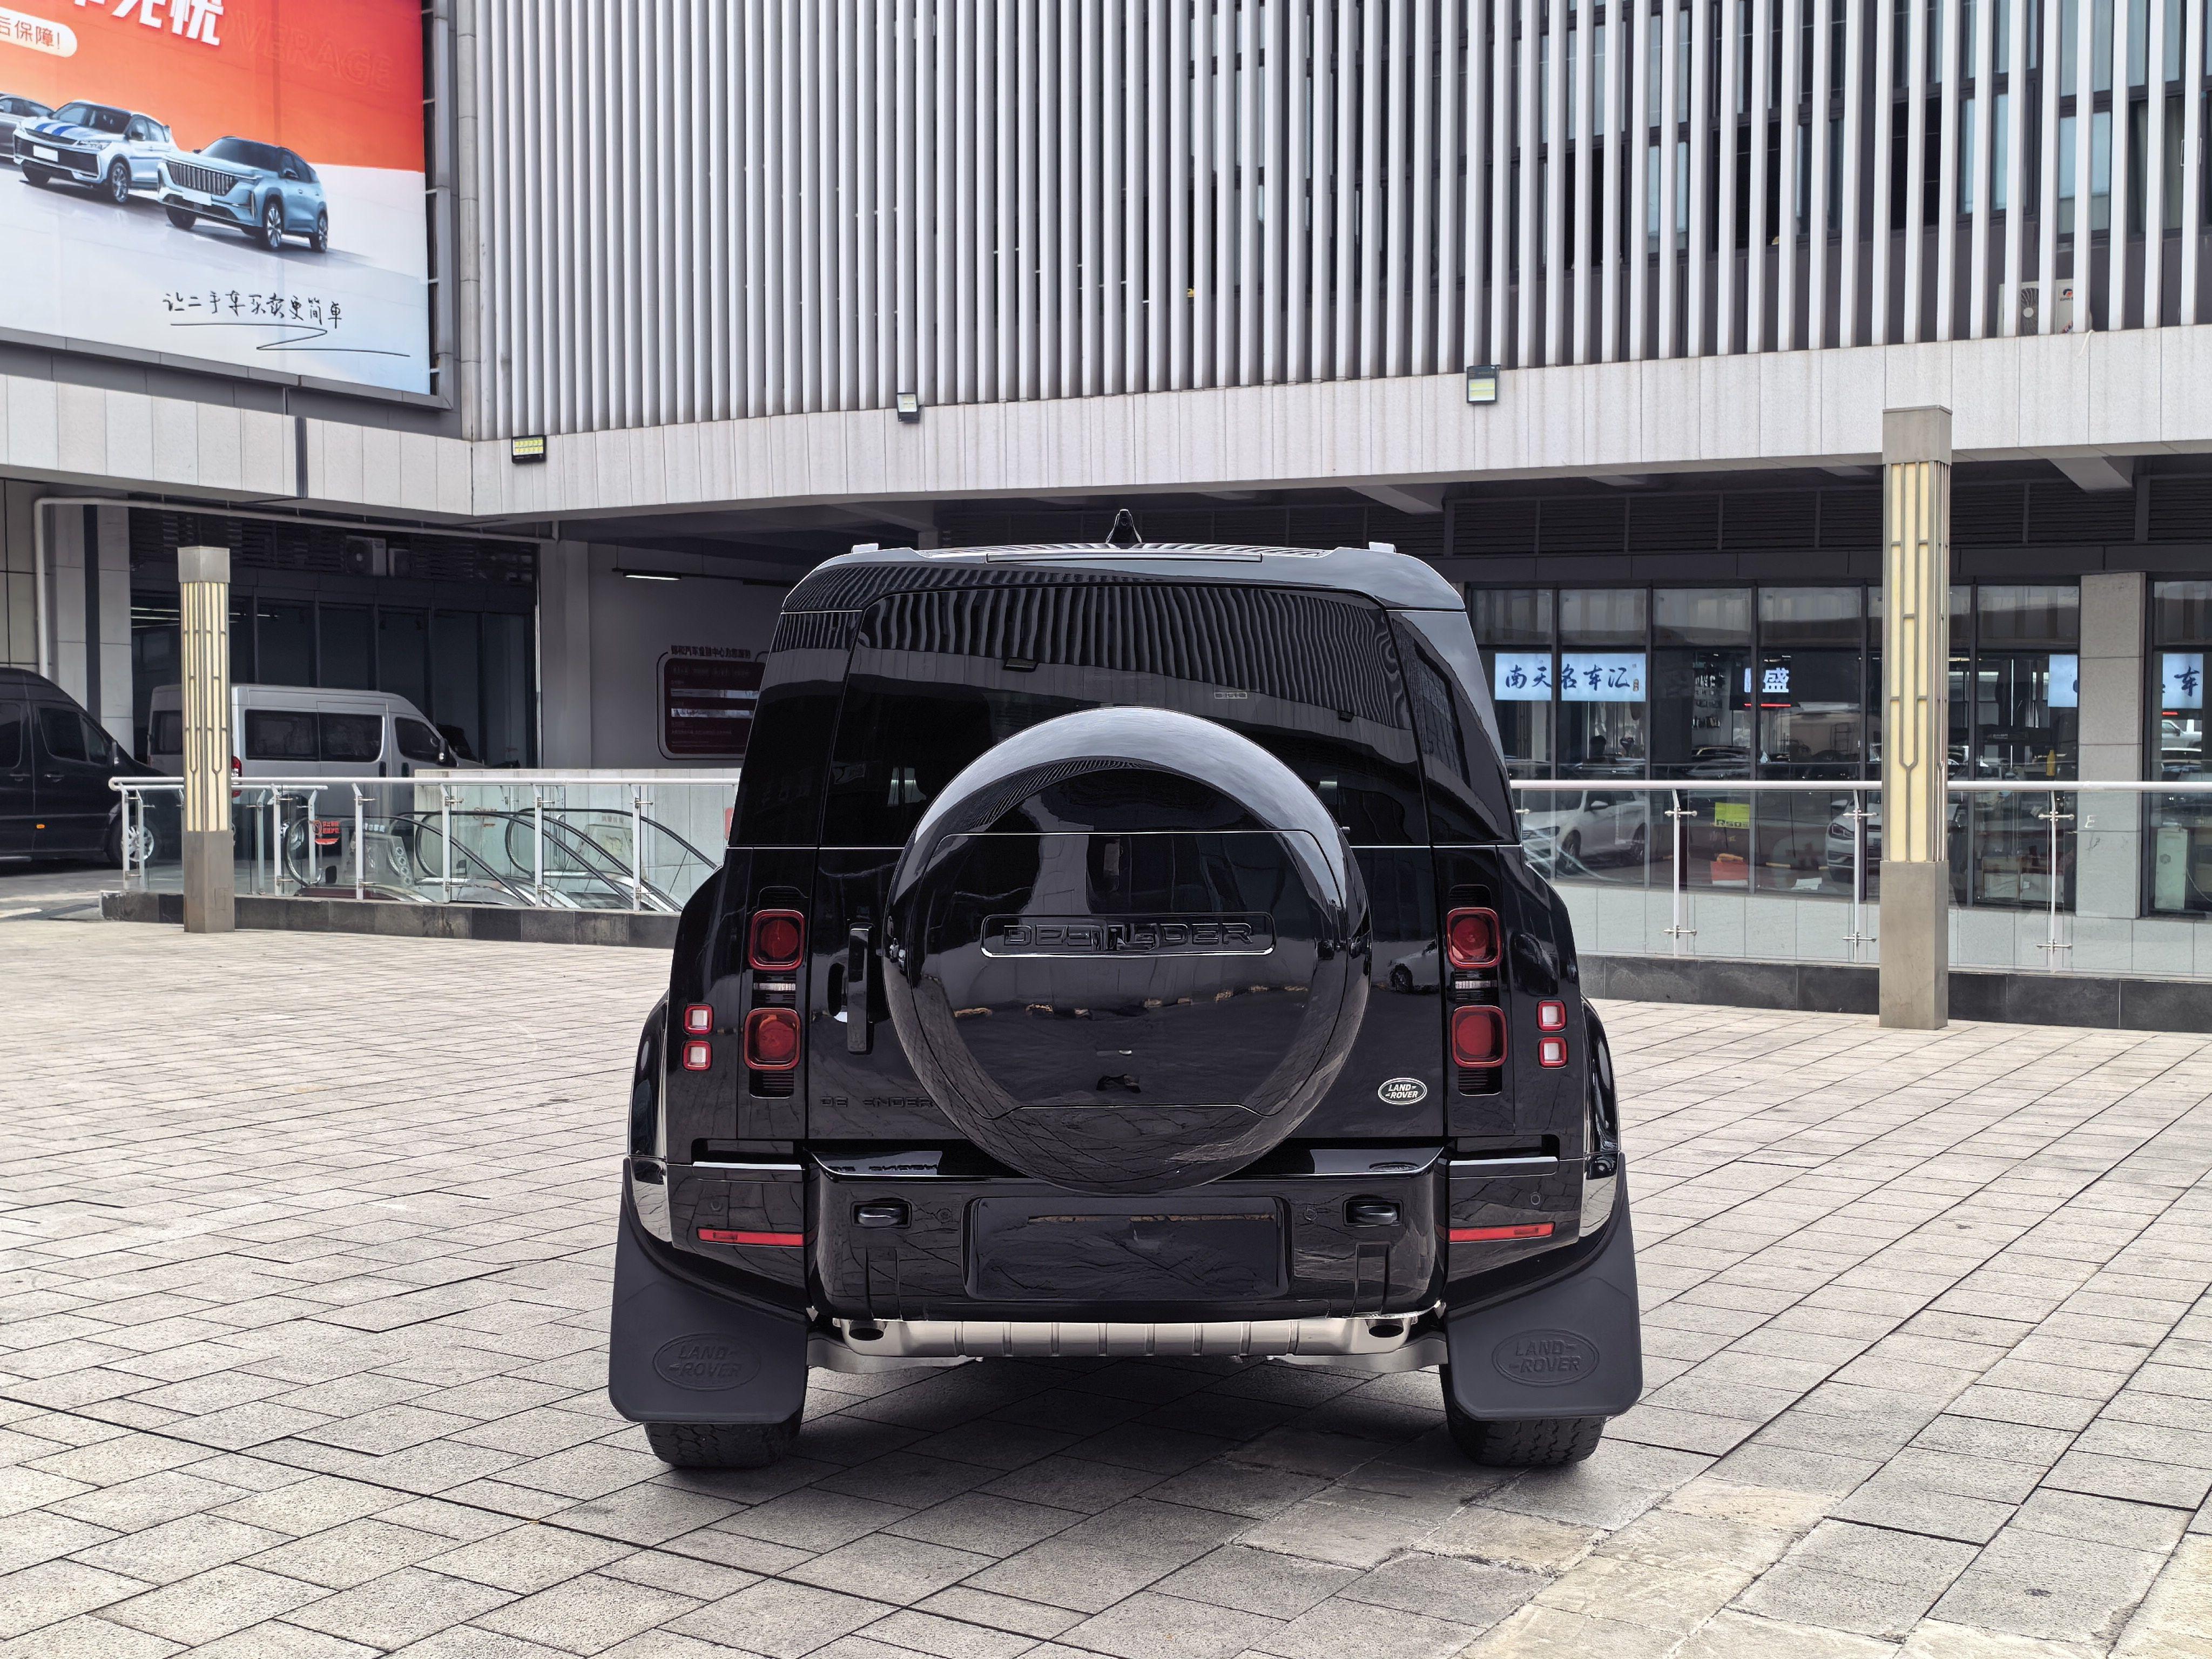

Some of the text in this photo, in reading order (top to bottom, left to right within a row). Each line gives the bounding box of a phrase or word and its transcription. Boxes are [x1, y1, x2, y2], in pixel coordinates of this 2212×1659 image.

[163, 290, 342, 329] 让二手车买卖更简单
[1506, 664, 1630, 691] 南天名车汇
[820, 1096, 934, 1108] DEENDER
[1390, 1091, 1419, 1099] ROVER
[1520, 1355, 1582, 1373] ROVER
